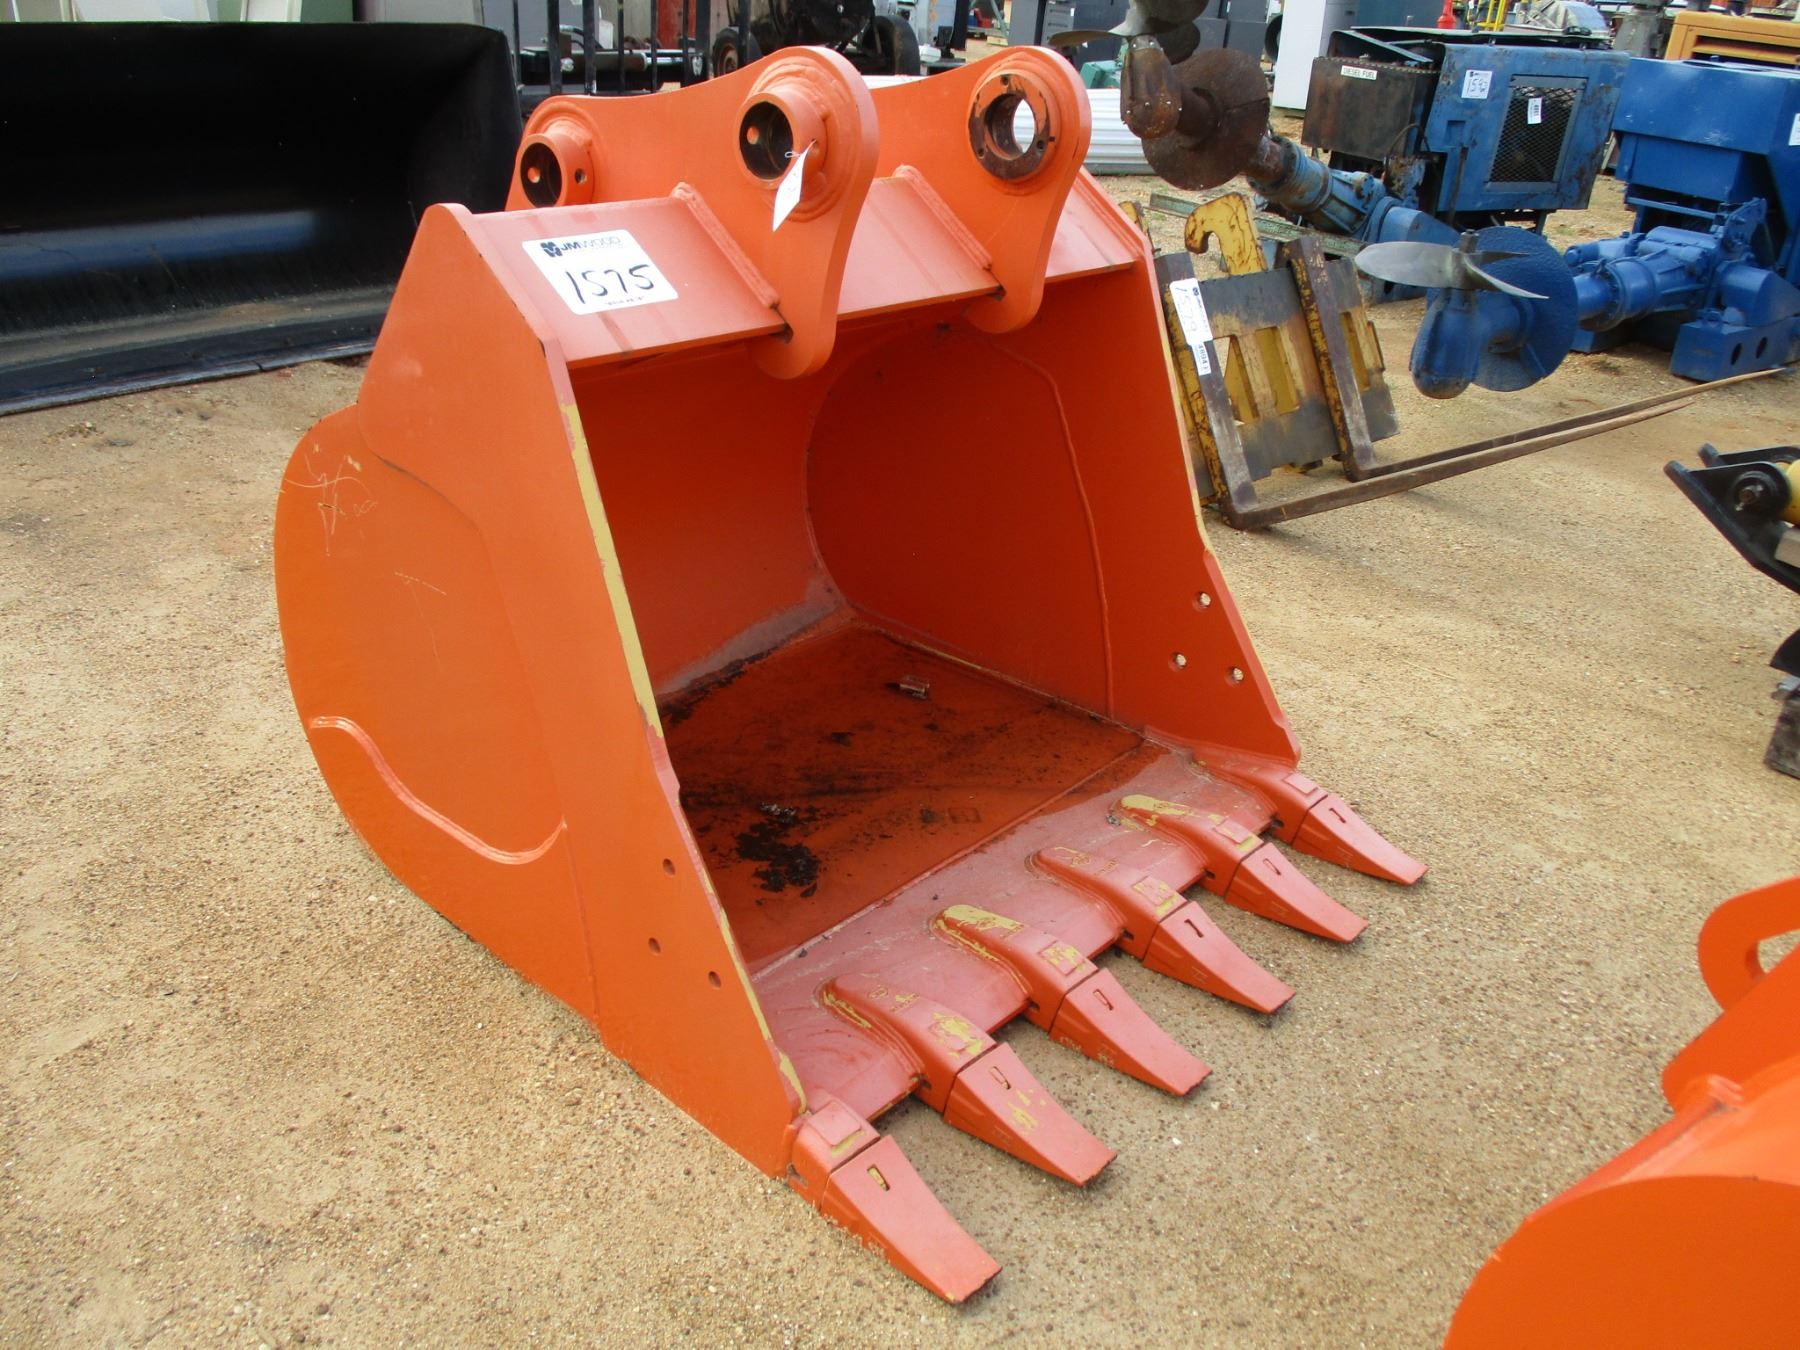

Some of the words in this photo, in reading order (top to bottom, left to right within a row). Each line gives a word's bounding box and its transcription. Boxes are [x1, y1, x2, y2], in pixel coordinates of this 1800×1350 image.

[1343, 67, 1361, 77] DIESEL
[1362, 70, 1375, 79] FUEL
[565, 264, 655, 304] 1575
